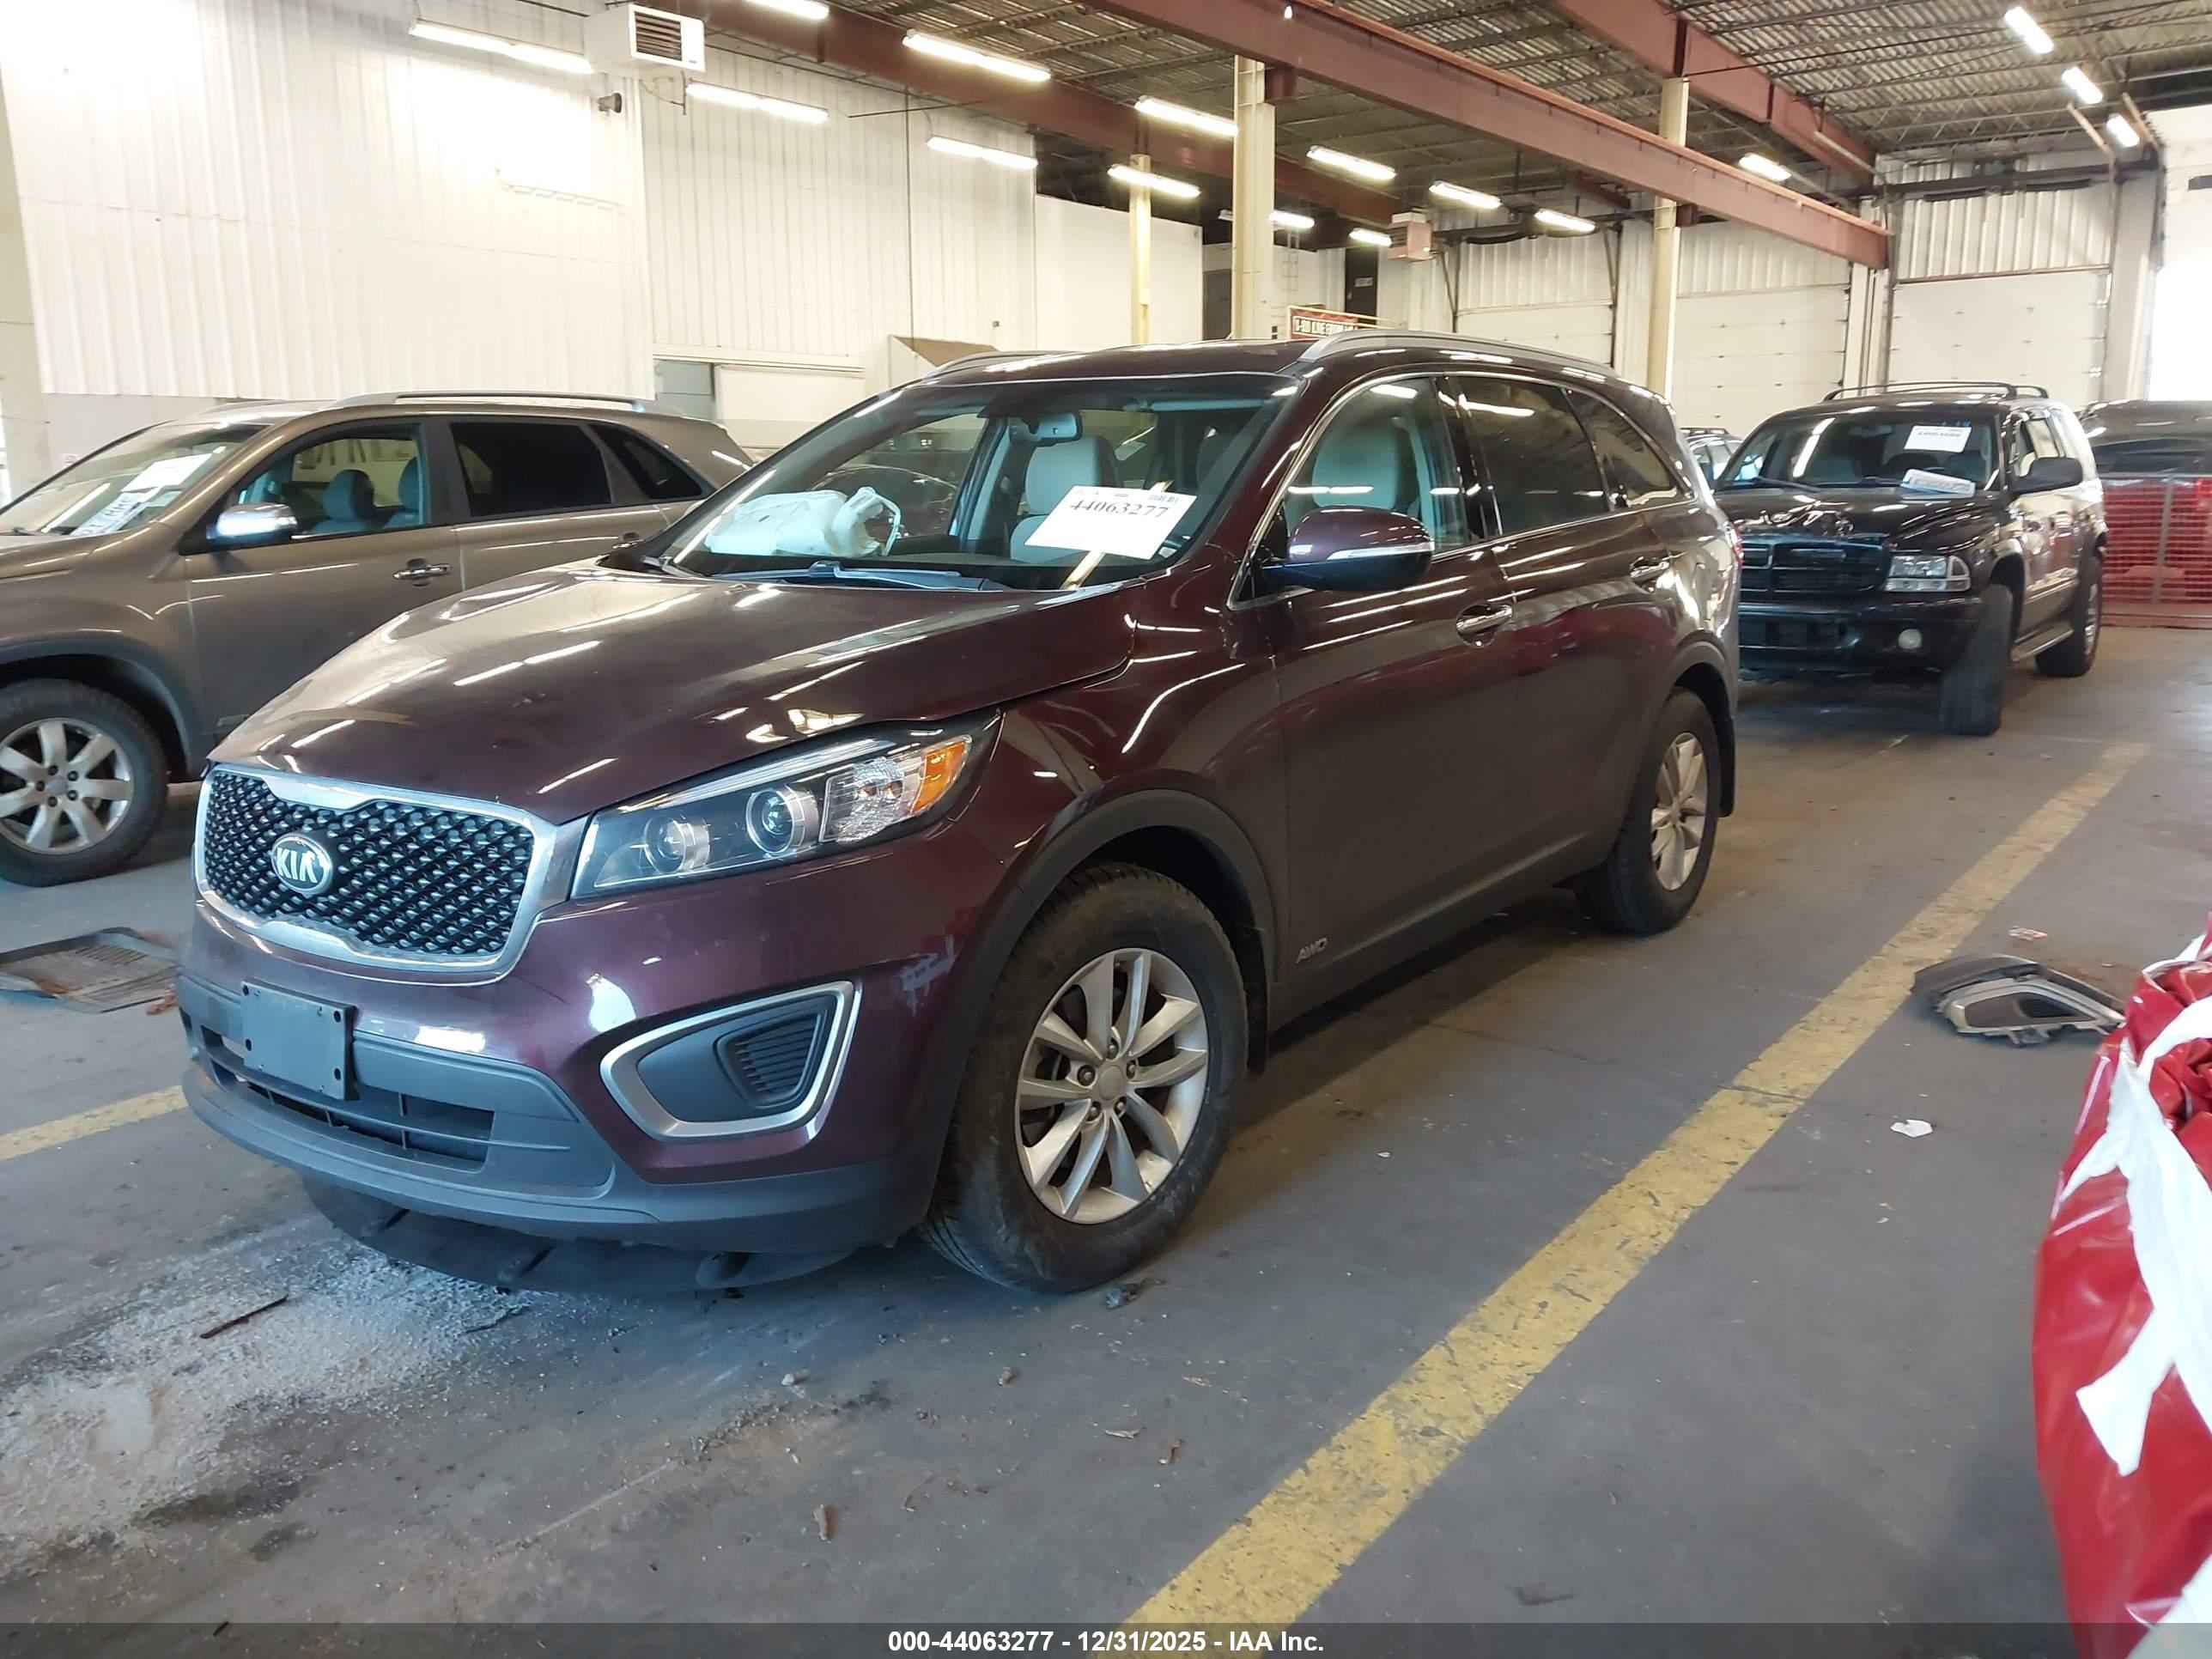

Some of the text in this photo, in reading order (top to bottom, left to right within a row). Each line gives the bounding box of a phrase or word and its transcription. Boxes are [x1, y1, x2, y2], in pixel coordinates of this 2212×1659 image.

[1070, 500, 1169, 518] 44063277
[276, 847, 319, 884] KIA
[1296, 937, 1328, 963] AWD
